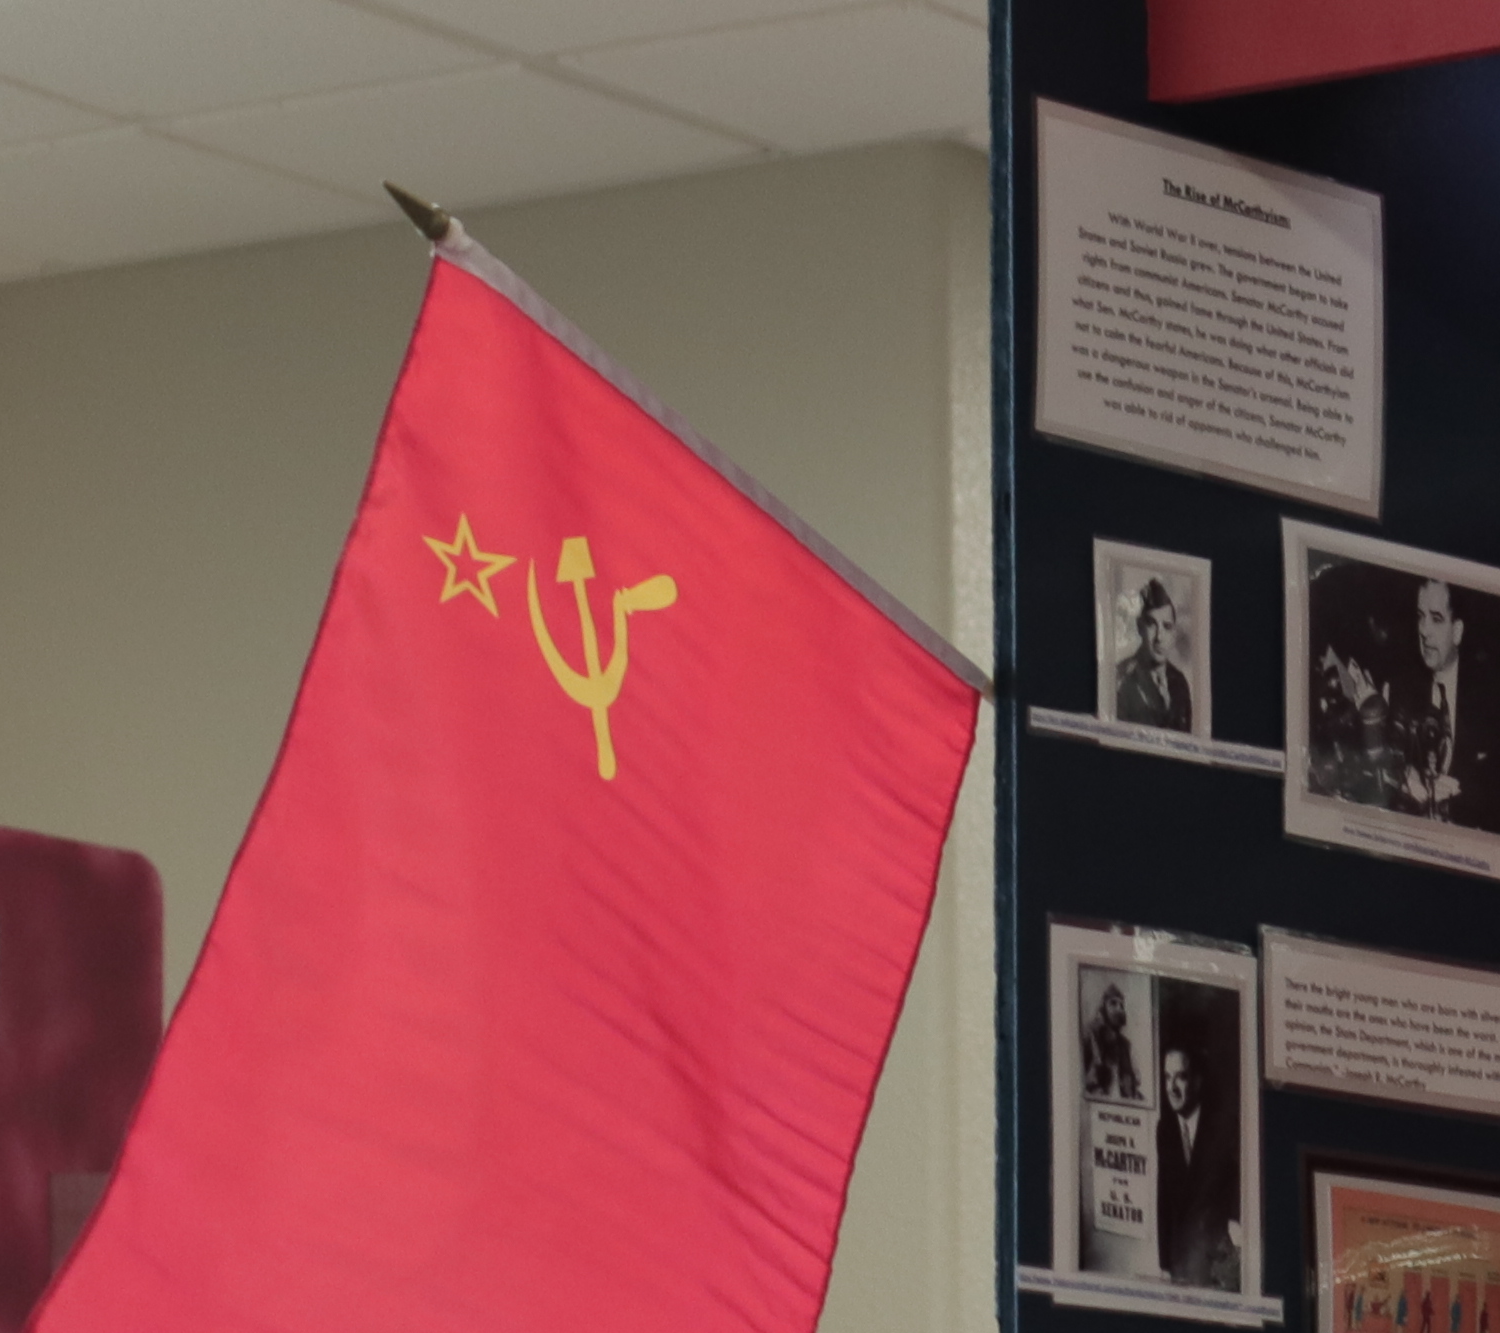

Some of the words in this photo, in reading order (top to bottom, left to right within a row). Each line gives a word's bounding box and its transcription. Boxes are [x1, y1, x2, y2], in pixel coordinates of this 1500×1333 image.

[1163, 178, 1181, 197] The
[1185, 184, 1206, 201] Rise
[1101, 1202, 1144, 1224] SENATOR
